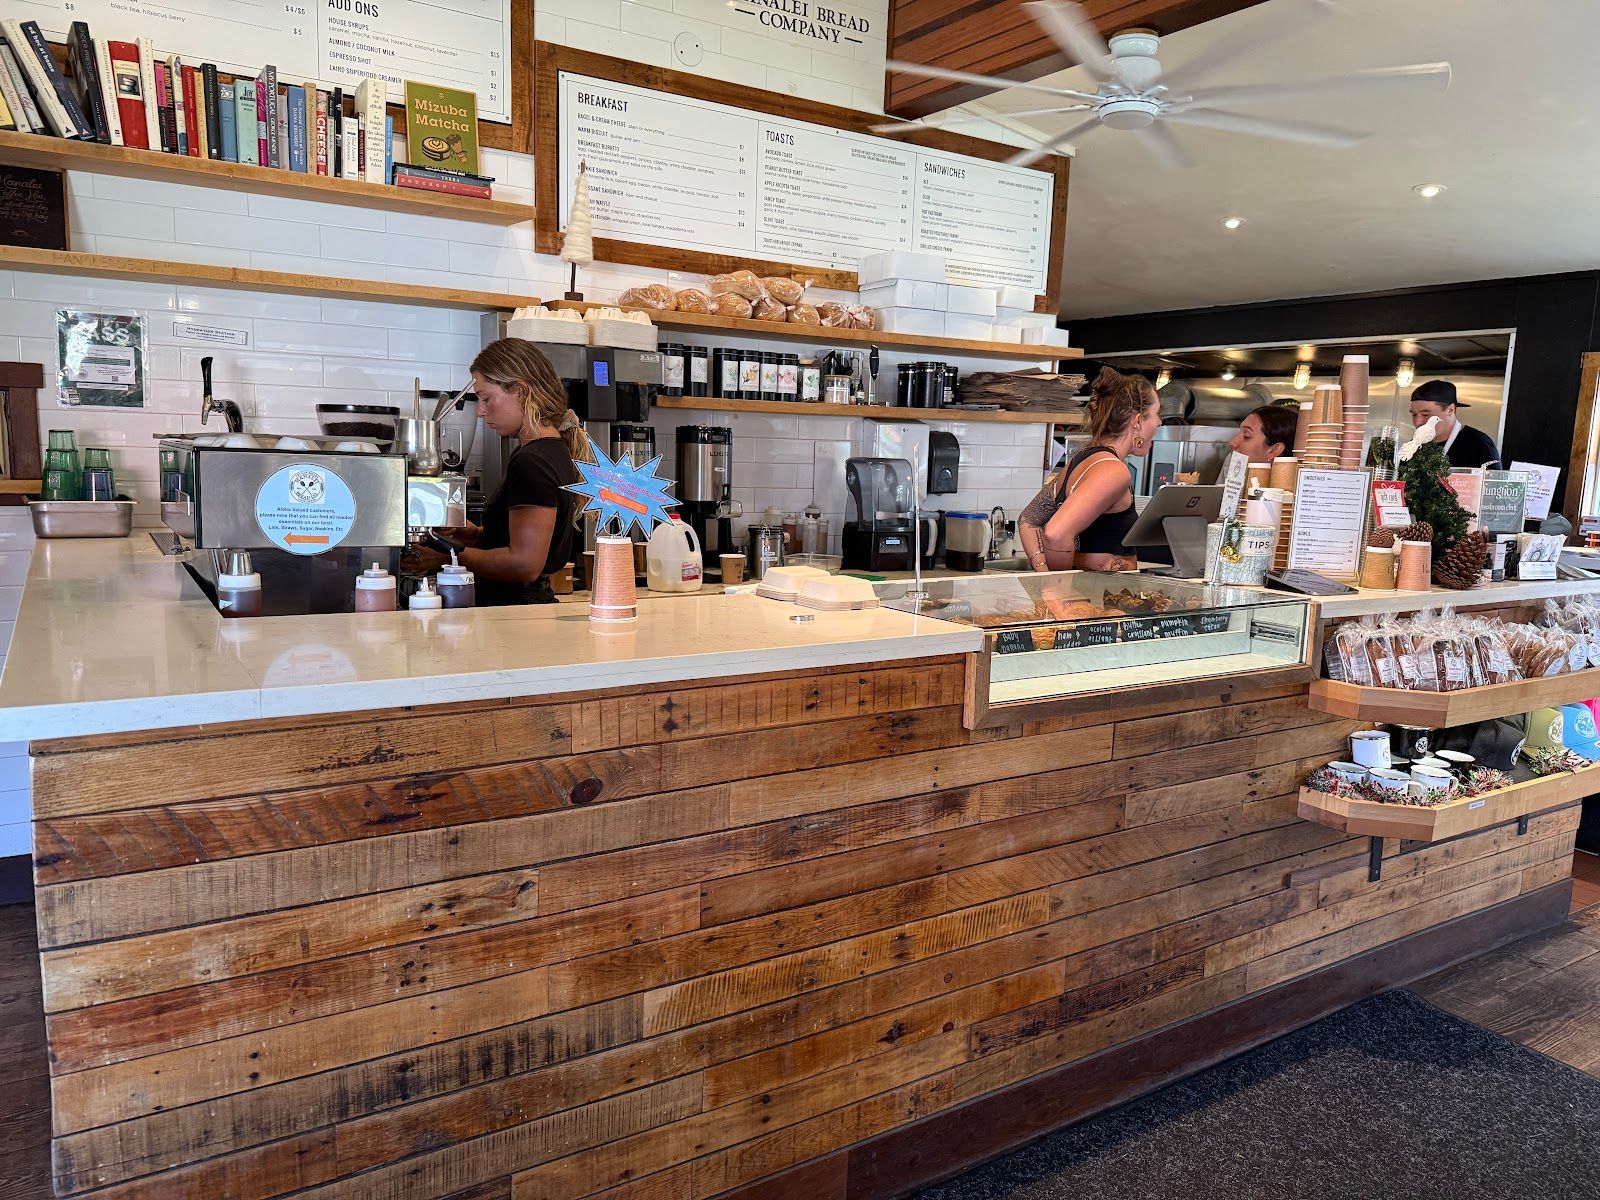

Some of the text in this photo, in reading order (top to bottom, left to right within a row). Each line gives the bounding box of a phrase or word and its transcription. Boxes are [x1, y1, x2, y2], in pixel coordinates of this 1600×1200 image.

[110, 2, 127, 11] black
[143, 8, 168, 19] hibiscus
[169, 12, 186, 23] berry
[328, 0, 379, 18] ADD ONS
[329, 17, 369, 31] HOUSE SYRUPS
[760, 10, 841, 44] COMPANY
[817, 7, 869, 33] BREAD
[28, 26, 35, 35] ad
[33, 35, 41, 46] hoc
[43, 54, 55, 73] home
[79, 26, 95, 82] UNDER PRESSURE
[329, 38, 351, 48] ALMOND
[356, 44, 381, 54] COCONUT
[383, 49, 395, 57] MILK
[329, 51, 372, 65] ESPRESSO SHOT
[268, 71, 275, 82] MY
[347, 68, 377, 80] SUPERFOOD
[378, 74, 402, 84] CREAMER
[268, 83, 276, 116] PORTUGAL
[578, 92, 628, 112] BREAKFAST
[415, 98, 468, 118] Mizuba
[415, 114, 470, 133] Matcha
[766, 130, 795, 146] TOASTS
[924, 162, 966, 179] SANDWICHES
[1248, 541, 1270, 549] TIPS
[1160, 618, 1189, 628] pumpkin
[1002, 632, 1019, 642] Baby
[1088, 634, 1113, 643] oissant
[1127, 630, 1153, 639] croissant
[1164, 628, 1189, 637] muffin
[1001, 644, 1025, 654] banana
